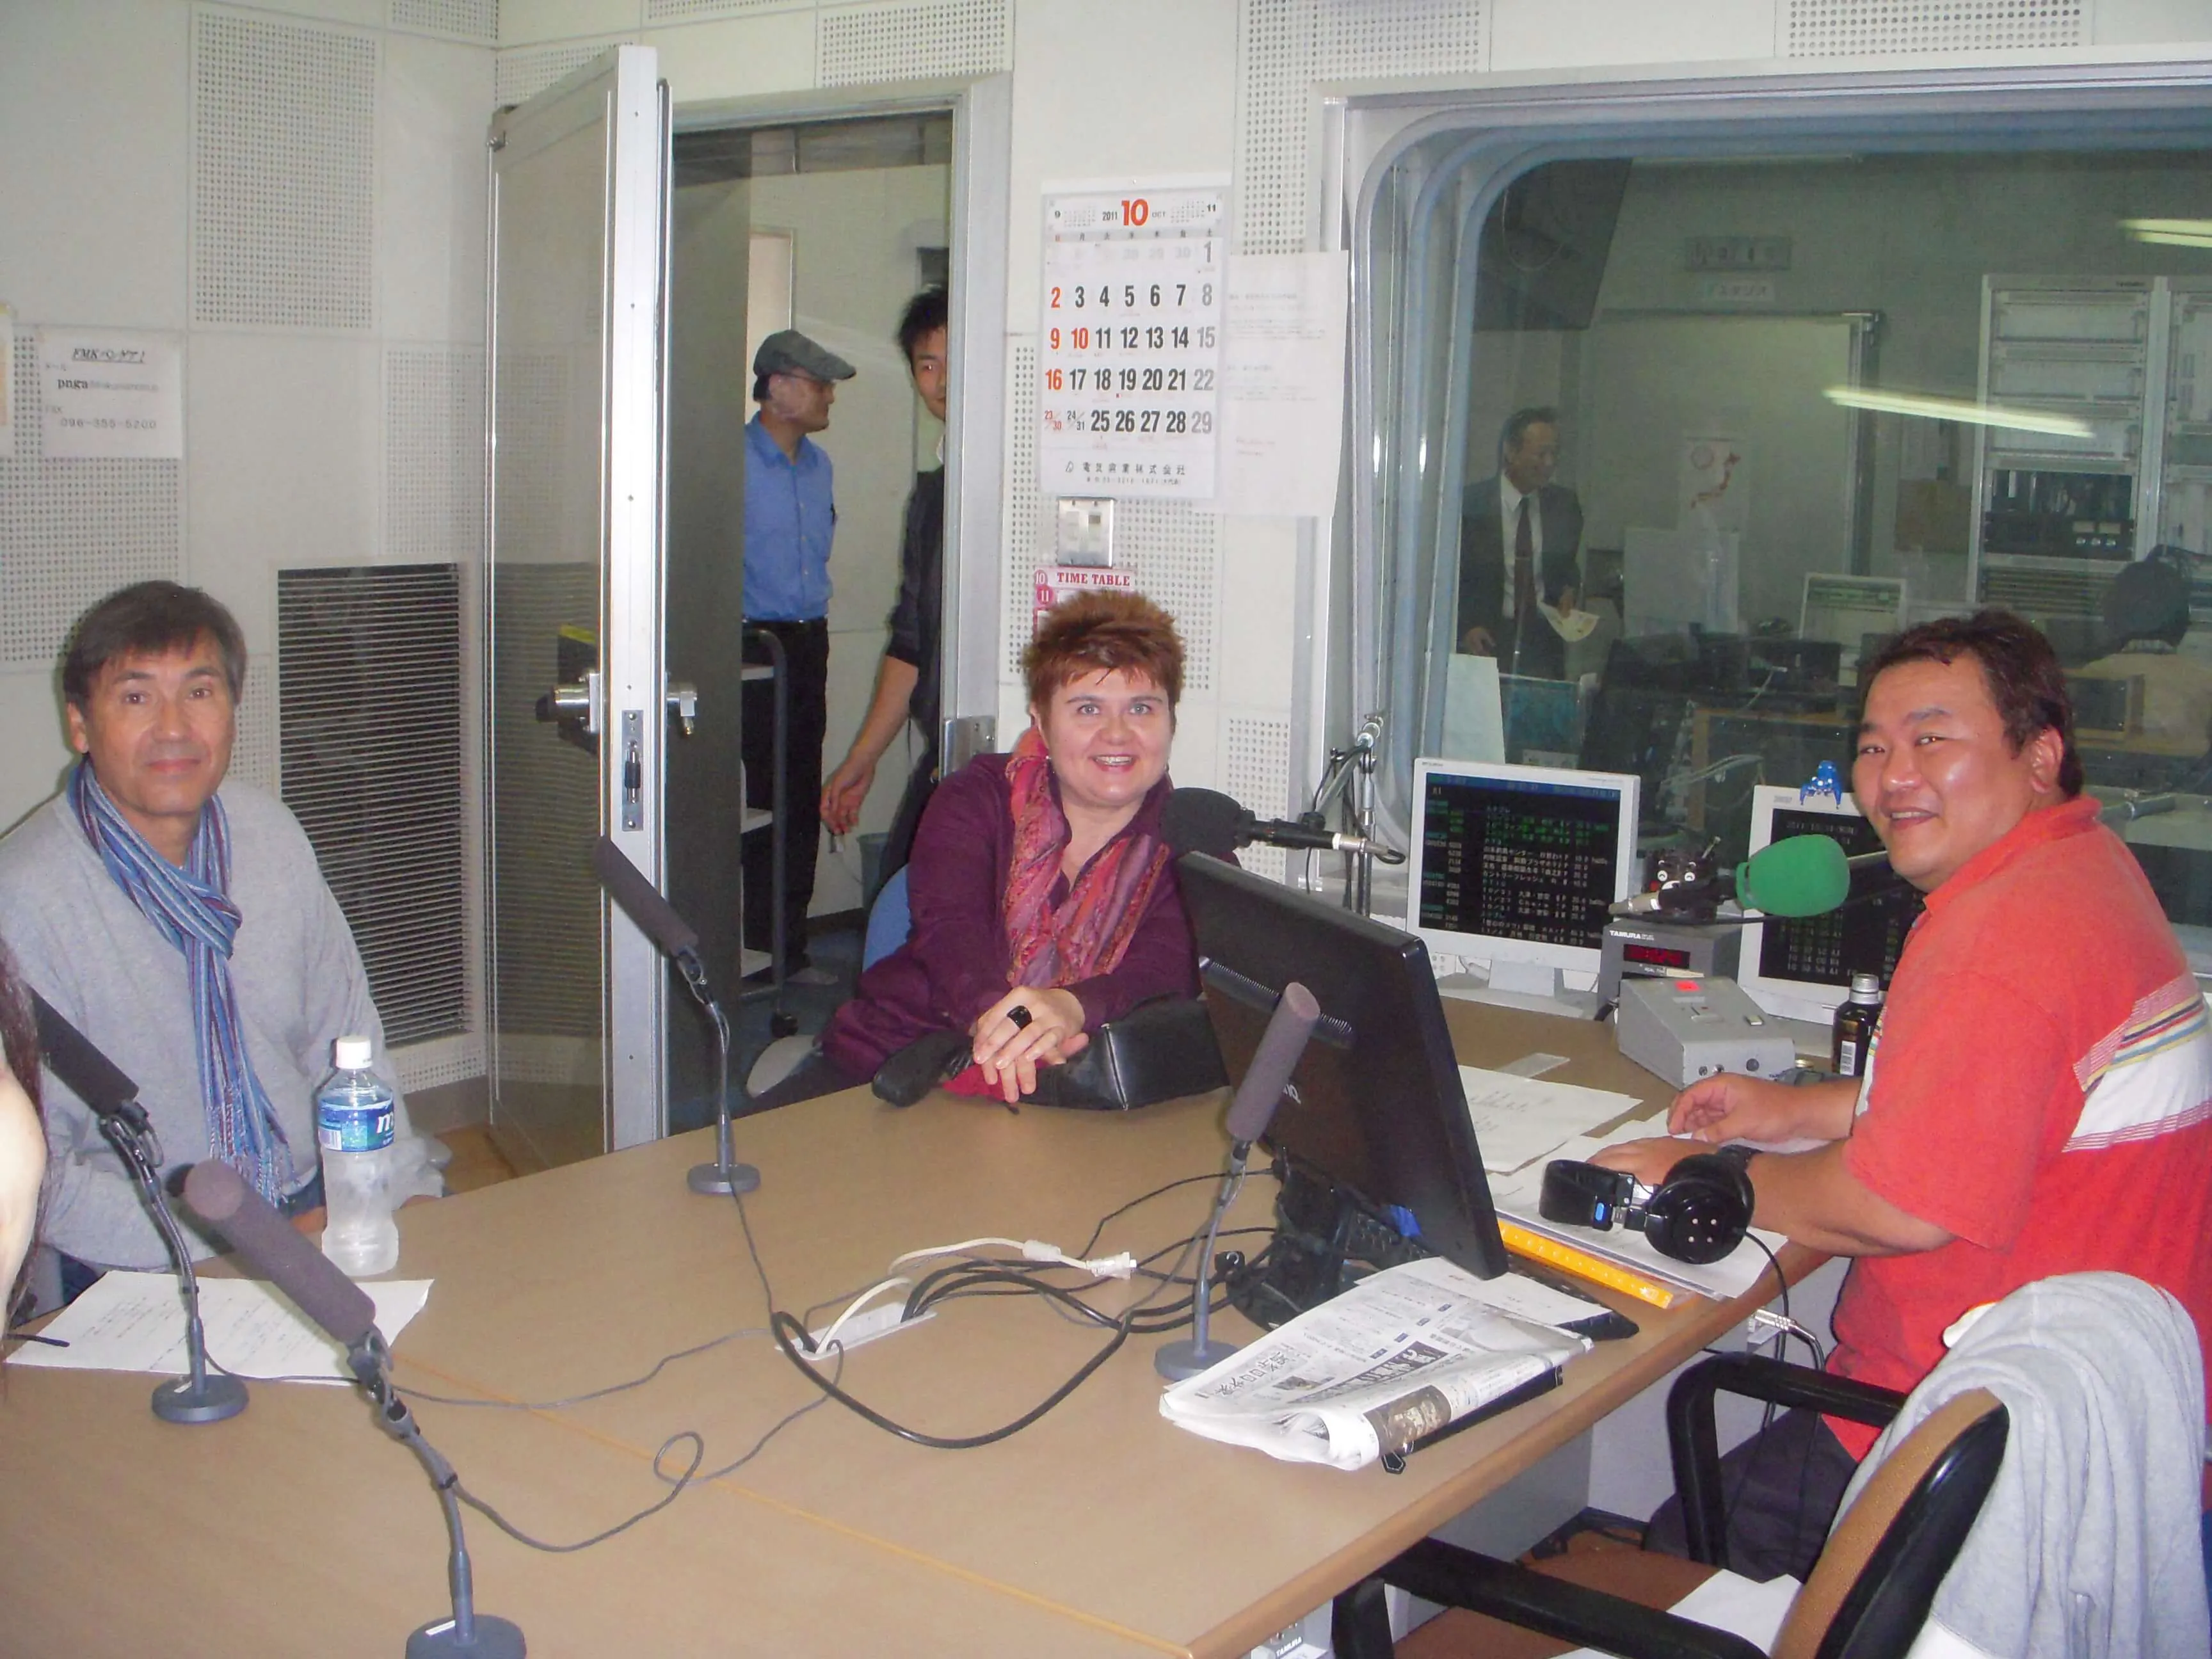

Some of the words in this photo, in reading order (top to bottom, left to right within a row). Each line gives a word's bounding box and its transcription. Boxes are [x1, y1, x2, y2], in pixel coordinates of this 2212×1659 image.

[1102, 211, 1118, 221] 2011
[1121, 198, 1148, 225] 10
[1206, 204, 1216, 212] 11
[1203, 241, 1212, 263] 1
[1051, 286, 1061, 309] 2
[1075, 285, 1085, 308] 3
[1100, 285, 1110, 307] 4
[1125, 285, 1134, 307] 5
[1150, 284, 1160, 307] 6
[1176, 284, 1186, 306] 7
[1202, 283, 1212, 307] 8
[1050, 327, 1060, 349] 9
[1071, 327, 1089, 349] 10
[1096, 327, 1111, 349] 11
[1120, 326, 1139, 349] 12
[1146, 326, 1164, 349] 13
[1171, 326, 1189, 349] 14
[1197, 326, 1215, 349] 15
[1045, 368, 1062, 390] 16
[1070, 368, 1087, 390] 17
[1094, 368, 1112, 390] 18
[1118, 368, 1137, 391] 19
[1142, 368, 1163, 391] 20
[1167, 368, 1186, 391] 21
[1193, 368, 1214, 391] 22
[1091, 410, 1110, 432] 25
[1115, 410, 1135, 433] 26
[1141, 410, 1160, 433] 27
[1166, 410, 1186, 433] 28
[1191, 410, 1212, 434] 29
[1036, 572, 1046, 584] 10
[1057, 572, 1088, 584] TIME
[1092, 573, 1130, 586] TABLE
[1041, 589, 1049, 602] 11
[1609, 930, 1641, 940] TAMURA
